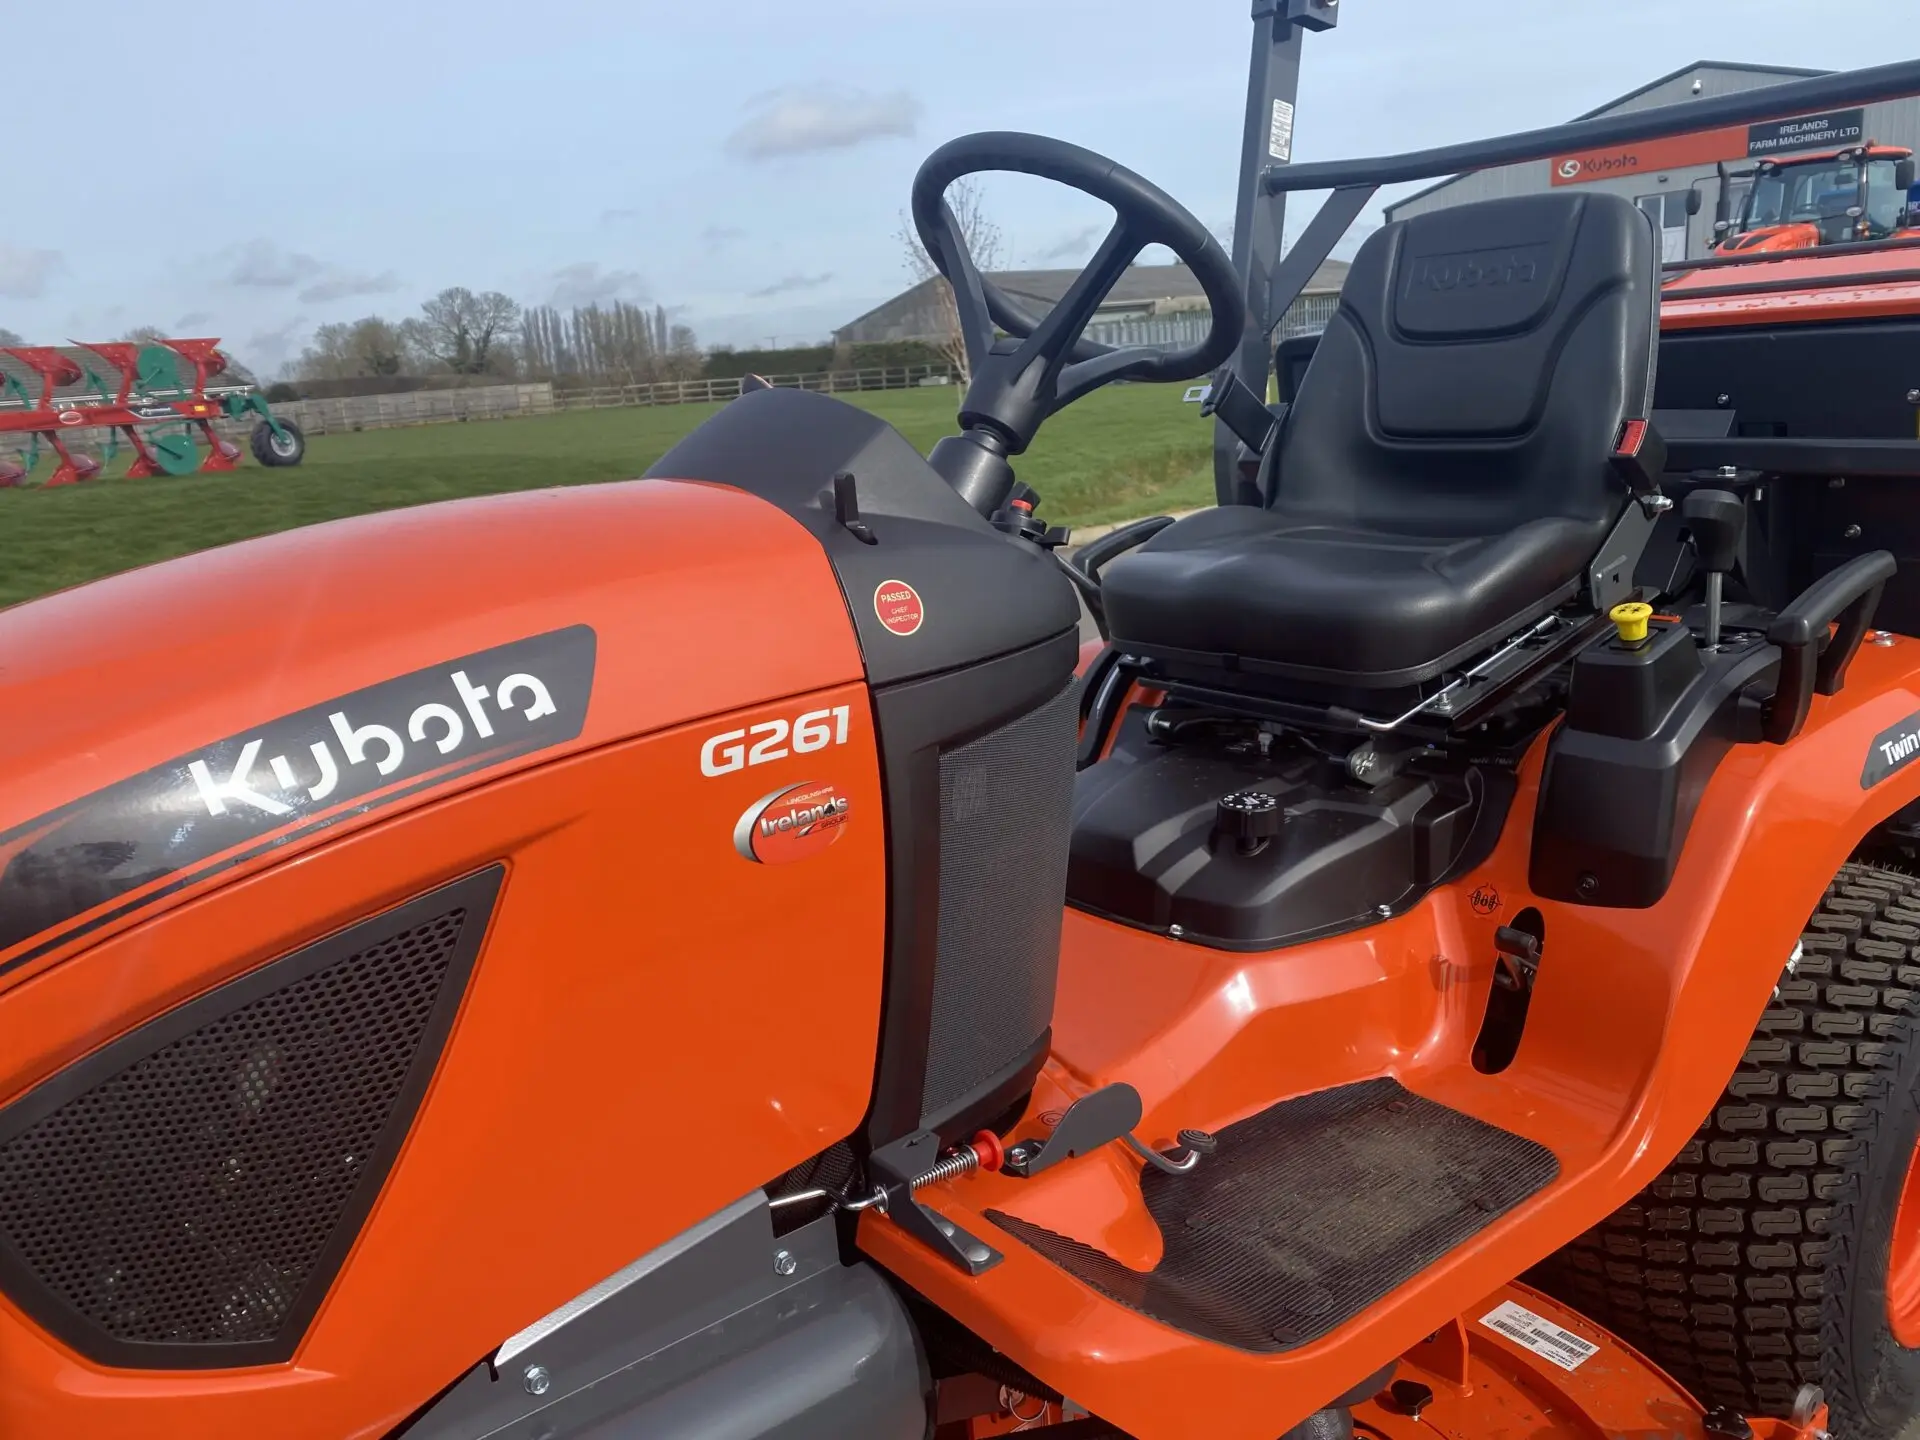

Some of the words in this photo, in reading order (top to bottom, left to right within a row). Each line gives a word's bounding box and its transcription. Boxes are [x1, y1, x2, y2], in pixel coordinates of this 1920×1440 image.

[1780, 119, 1828, 134] IRELANDS
[1749, 138, 1777, 150] FARM
[1779, 129, 1838, 146] MACHINERY
[1839, 126, 1859, 137] LTD
[1583, 153, 1638, 172] Kubota
[1418, 254, 1536, 291] Kubota
[880, 590, 911, 604] PASSED
[886, 613, 918, 624] INSPECTOR
[891, 605, 908, 615] CHIEF
[187, 670, 557, 817] Kubota
[700, 704, 850, 778] G261
[786, 786, 834, 806] LINCOLNSHIRE
[760, 796, 848, 838] Irelands
[820, 814, 848, 829] GROUP
